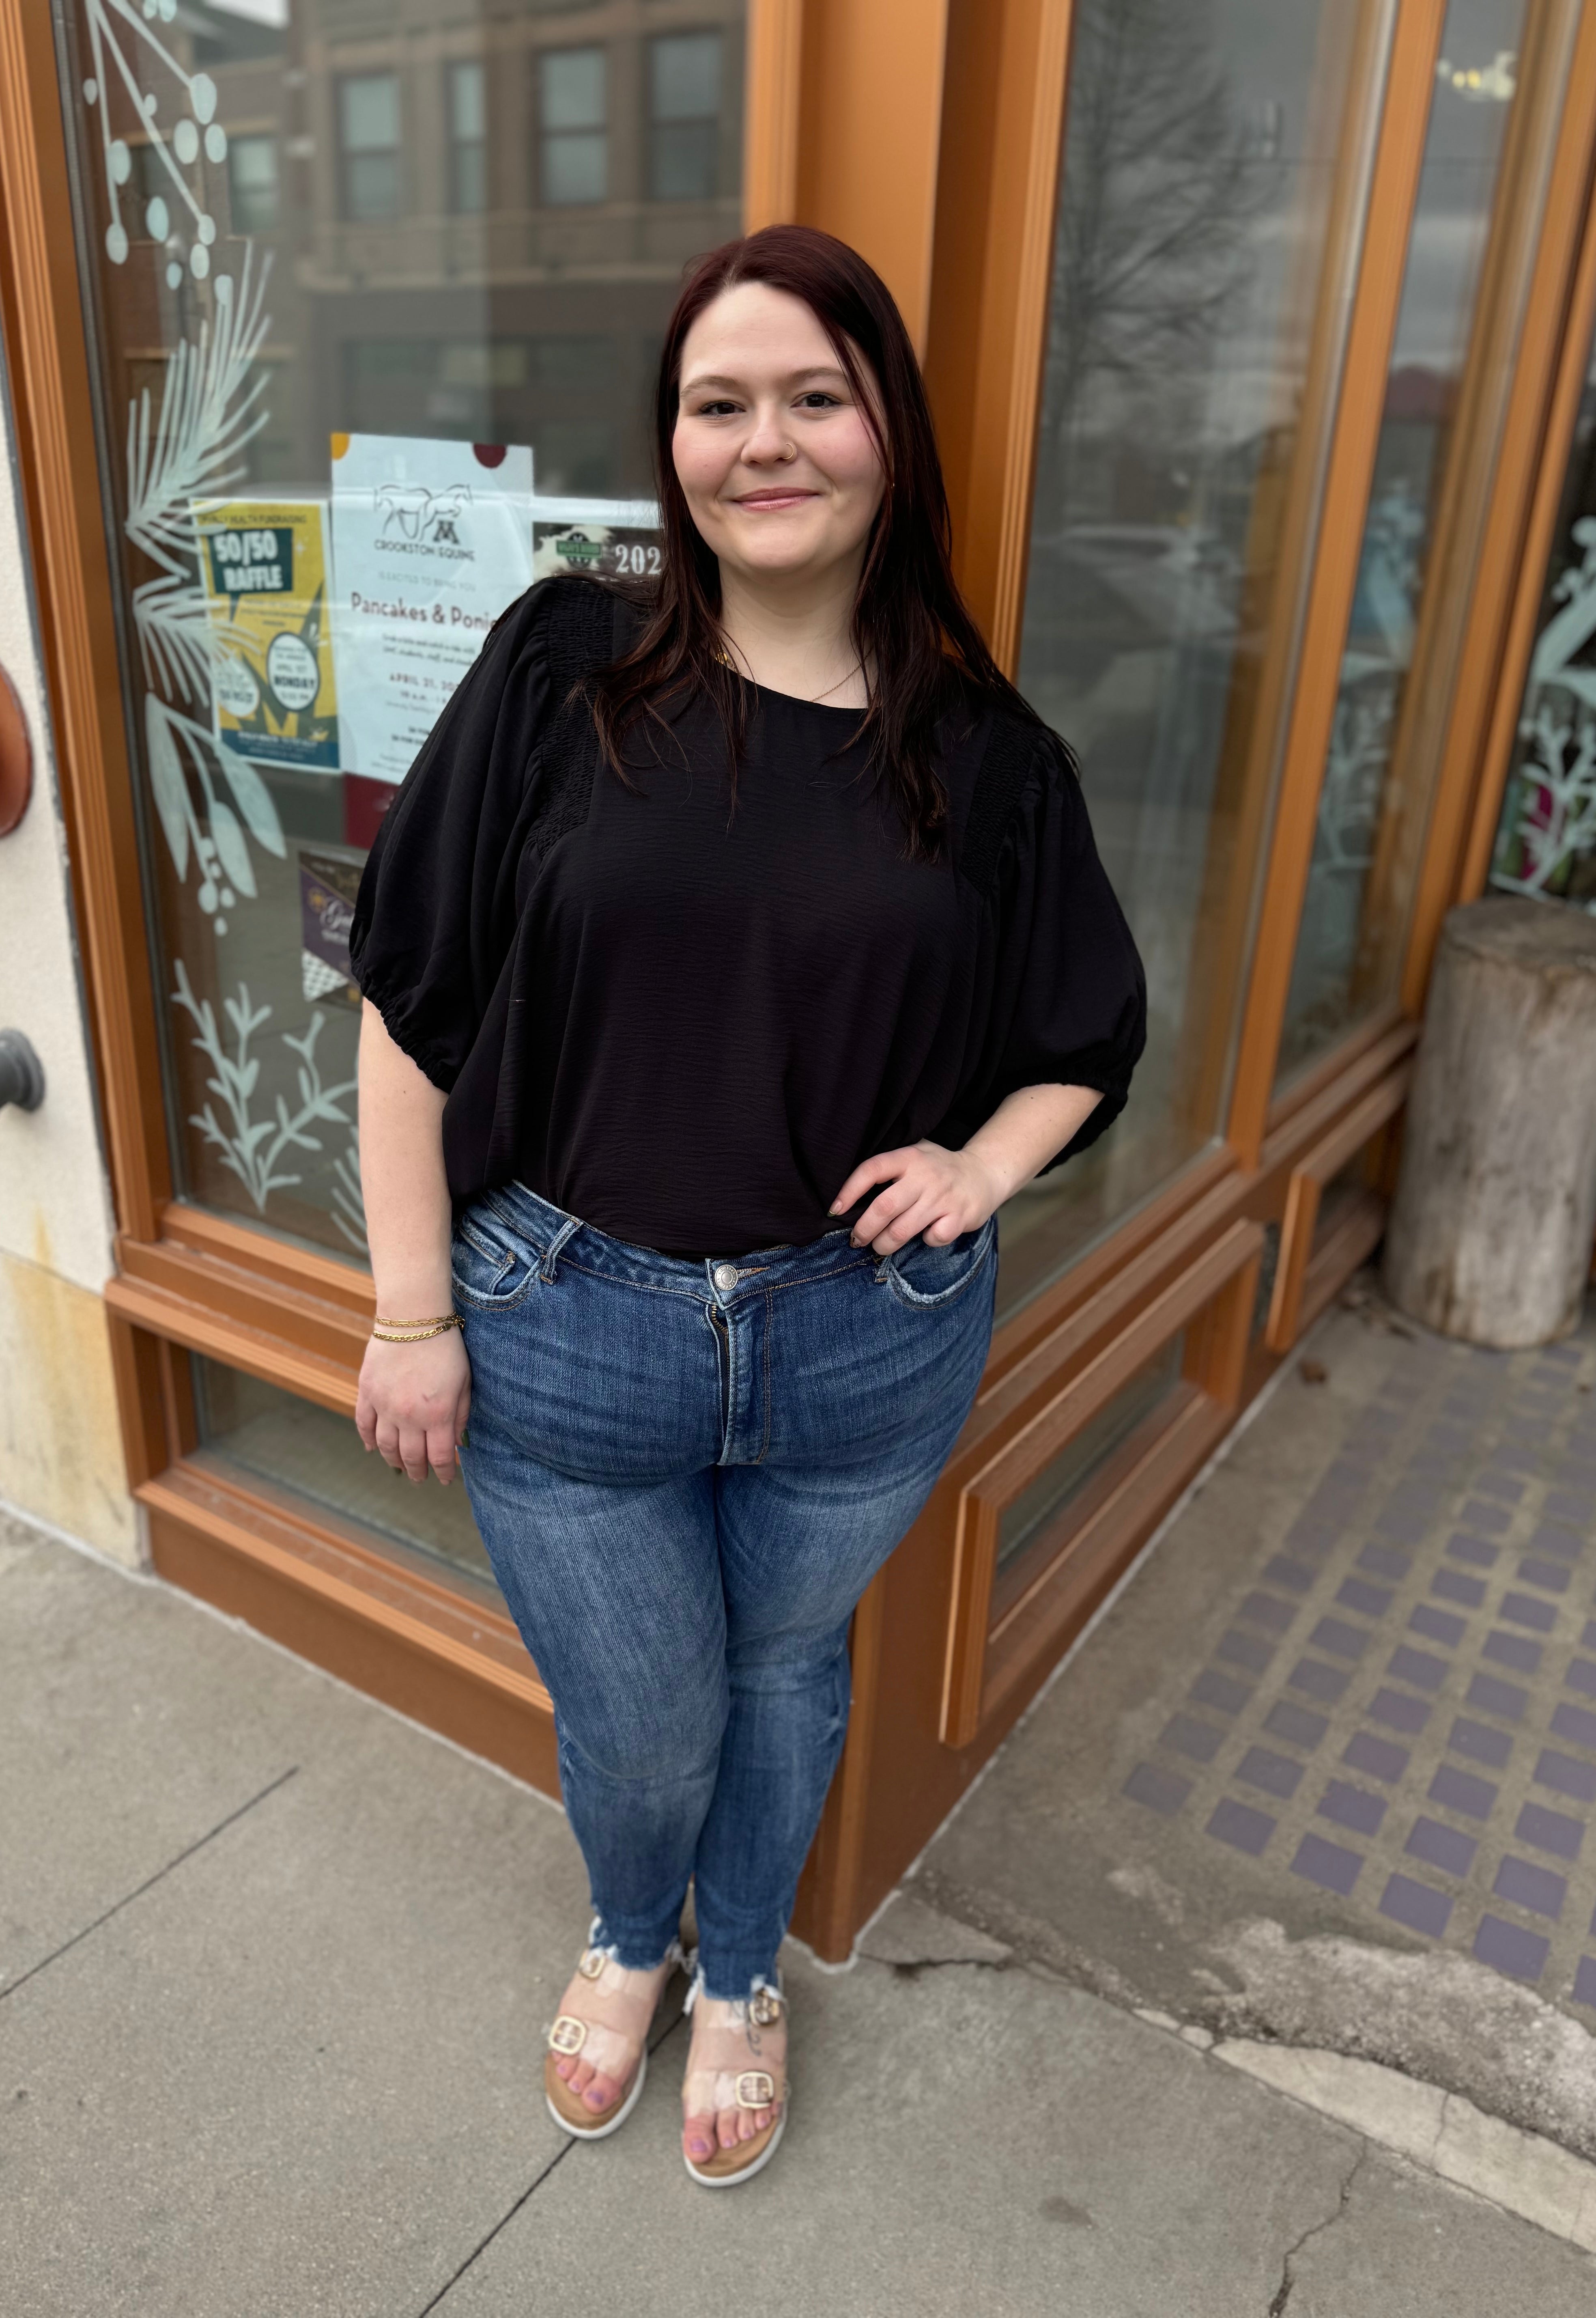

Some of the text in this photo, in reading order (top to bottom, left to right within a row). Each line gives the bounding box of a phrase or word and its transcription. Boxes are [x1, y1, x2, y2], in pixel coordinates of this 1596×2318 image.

[213, 529, 278, 567] 50/50
[374, 539, 476, 562] CROOKSTON EQUINE
[615, 544, 662, 575] 202
[223, 564, 284, 591] RAFFLE
[351, 591, 427, 623] Pancakes
[432, 603, 445, 625] &
